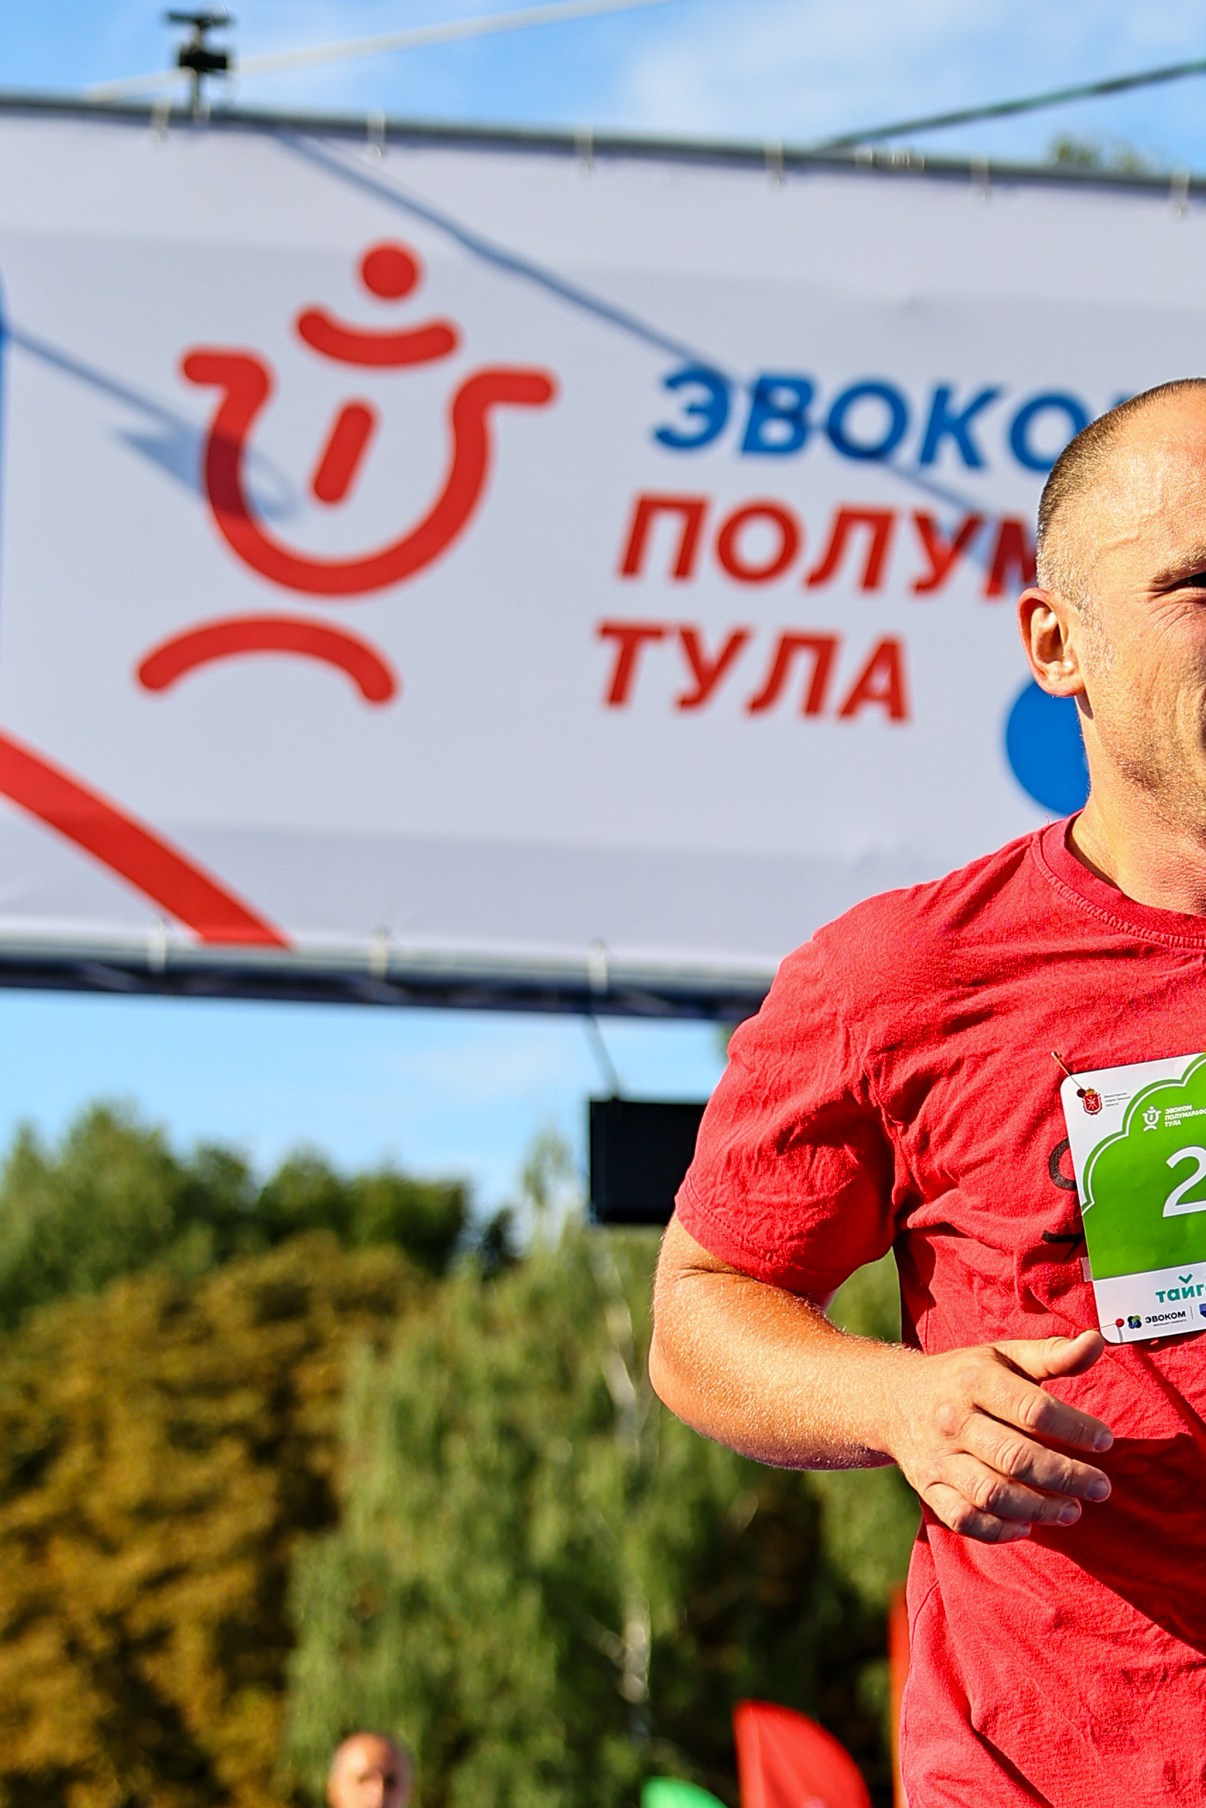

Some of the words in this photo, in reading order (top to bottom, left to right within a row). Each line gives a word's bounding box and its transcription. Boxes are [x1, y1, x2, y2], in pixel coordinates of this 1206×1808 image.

[652, 360, 1112, 474] ЭВОКО
[596, 618, 912, 724] ТУЛА
[1164, 1119, 1182, 1128] ТУЛА
[1145, 1310, 1187, 1324] ЭВОКОМ
